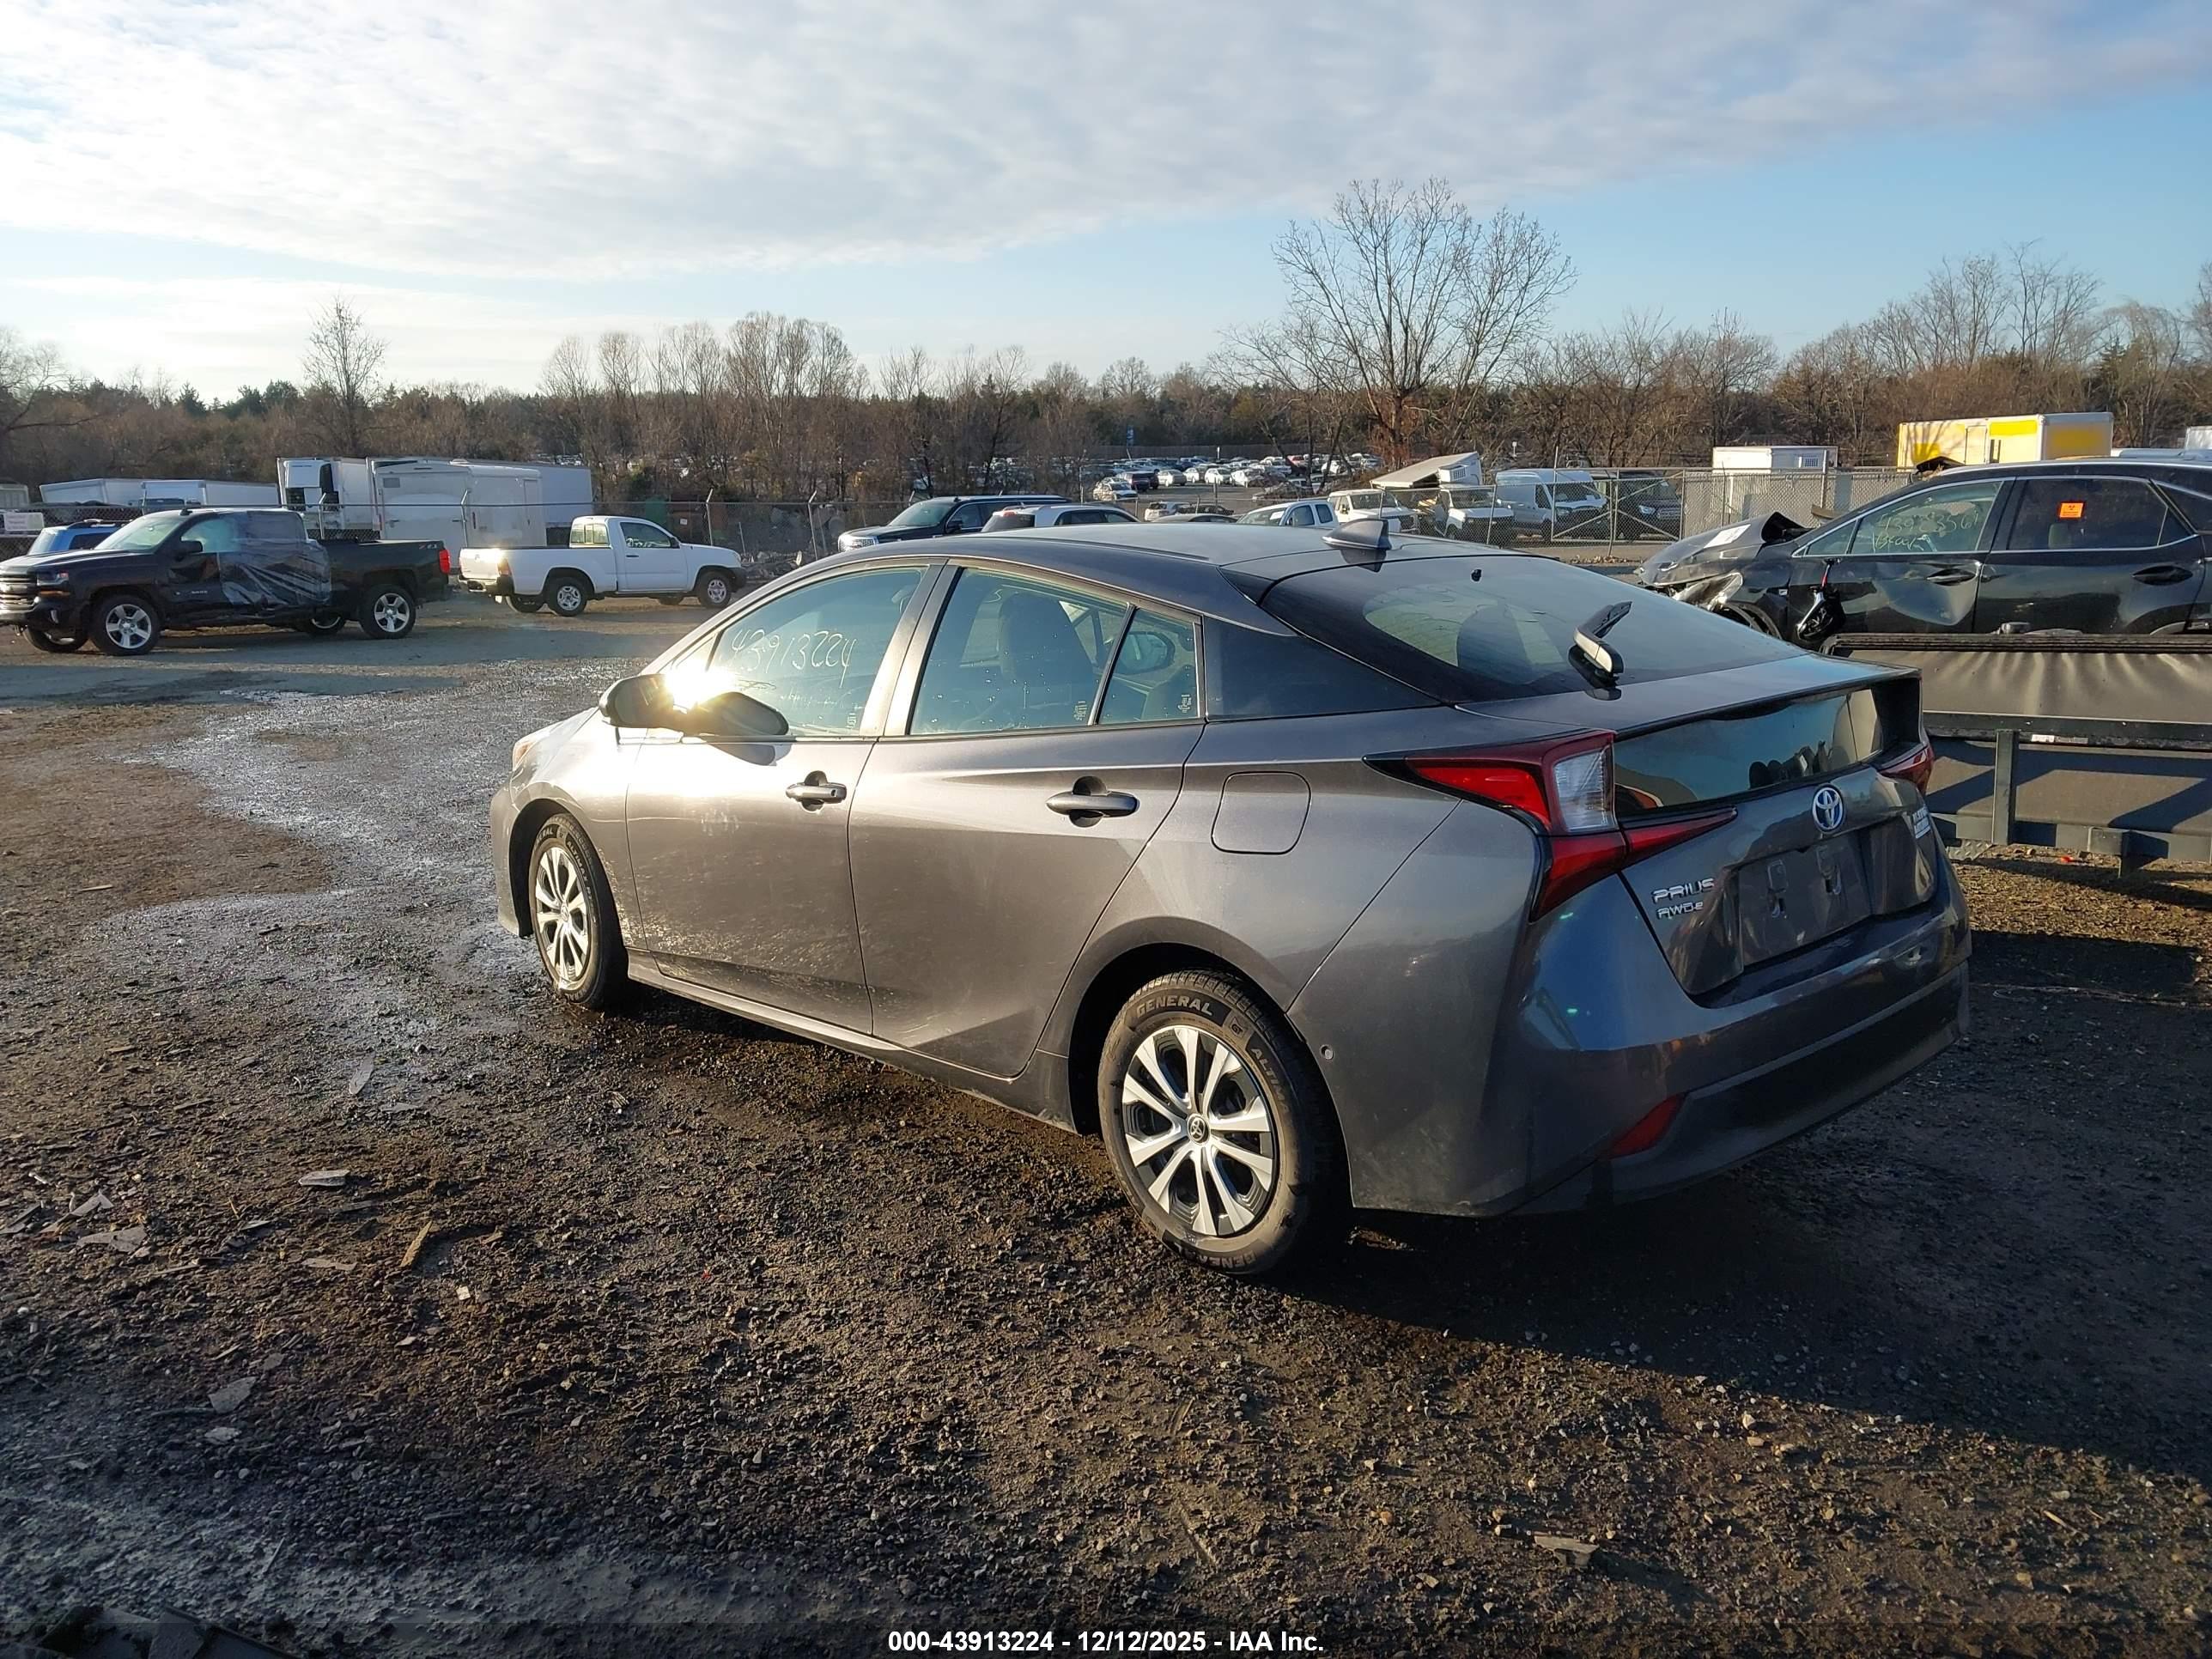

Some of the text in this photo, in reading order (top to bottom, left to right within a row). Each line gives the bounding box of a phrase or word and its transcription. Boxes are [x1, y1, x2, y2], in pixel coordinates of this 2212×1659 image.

[729, 629, 857, 689] 43913224
[567, 841, 588, 882] ALTIMAX
[1652, 878, 1715, 903] PRIUS
[1136, 995, 1213, 1018] GENERAL
[1250, 1048, 1291, 1126] ALTIMA
[1174, 1242, 1257, 1269] GENERL
